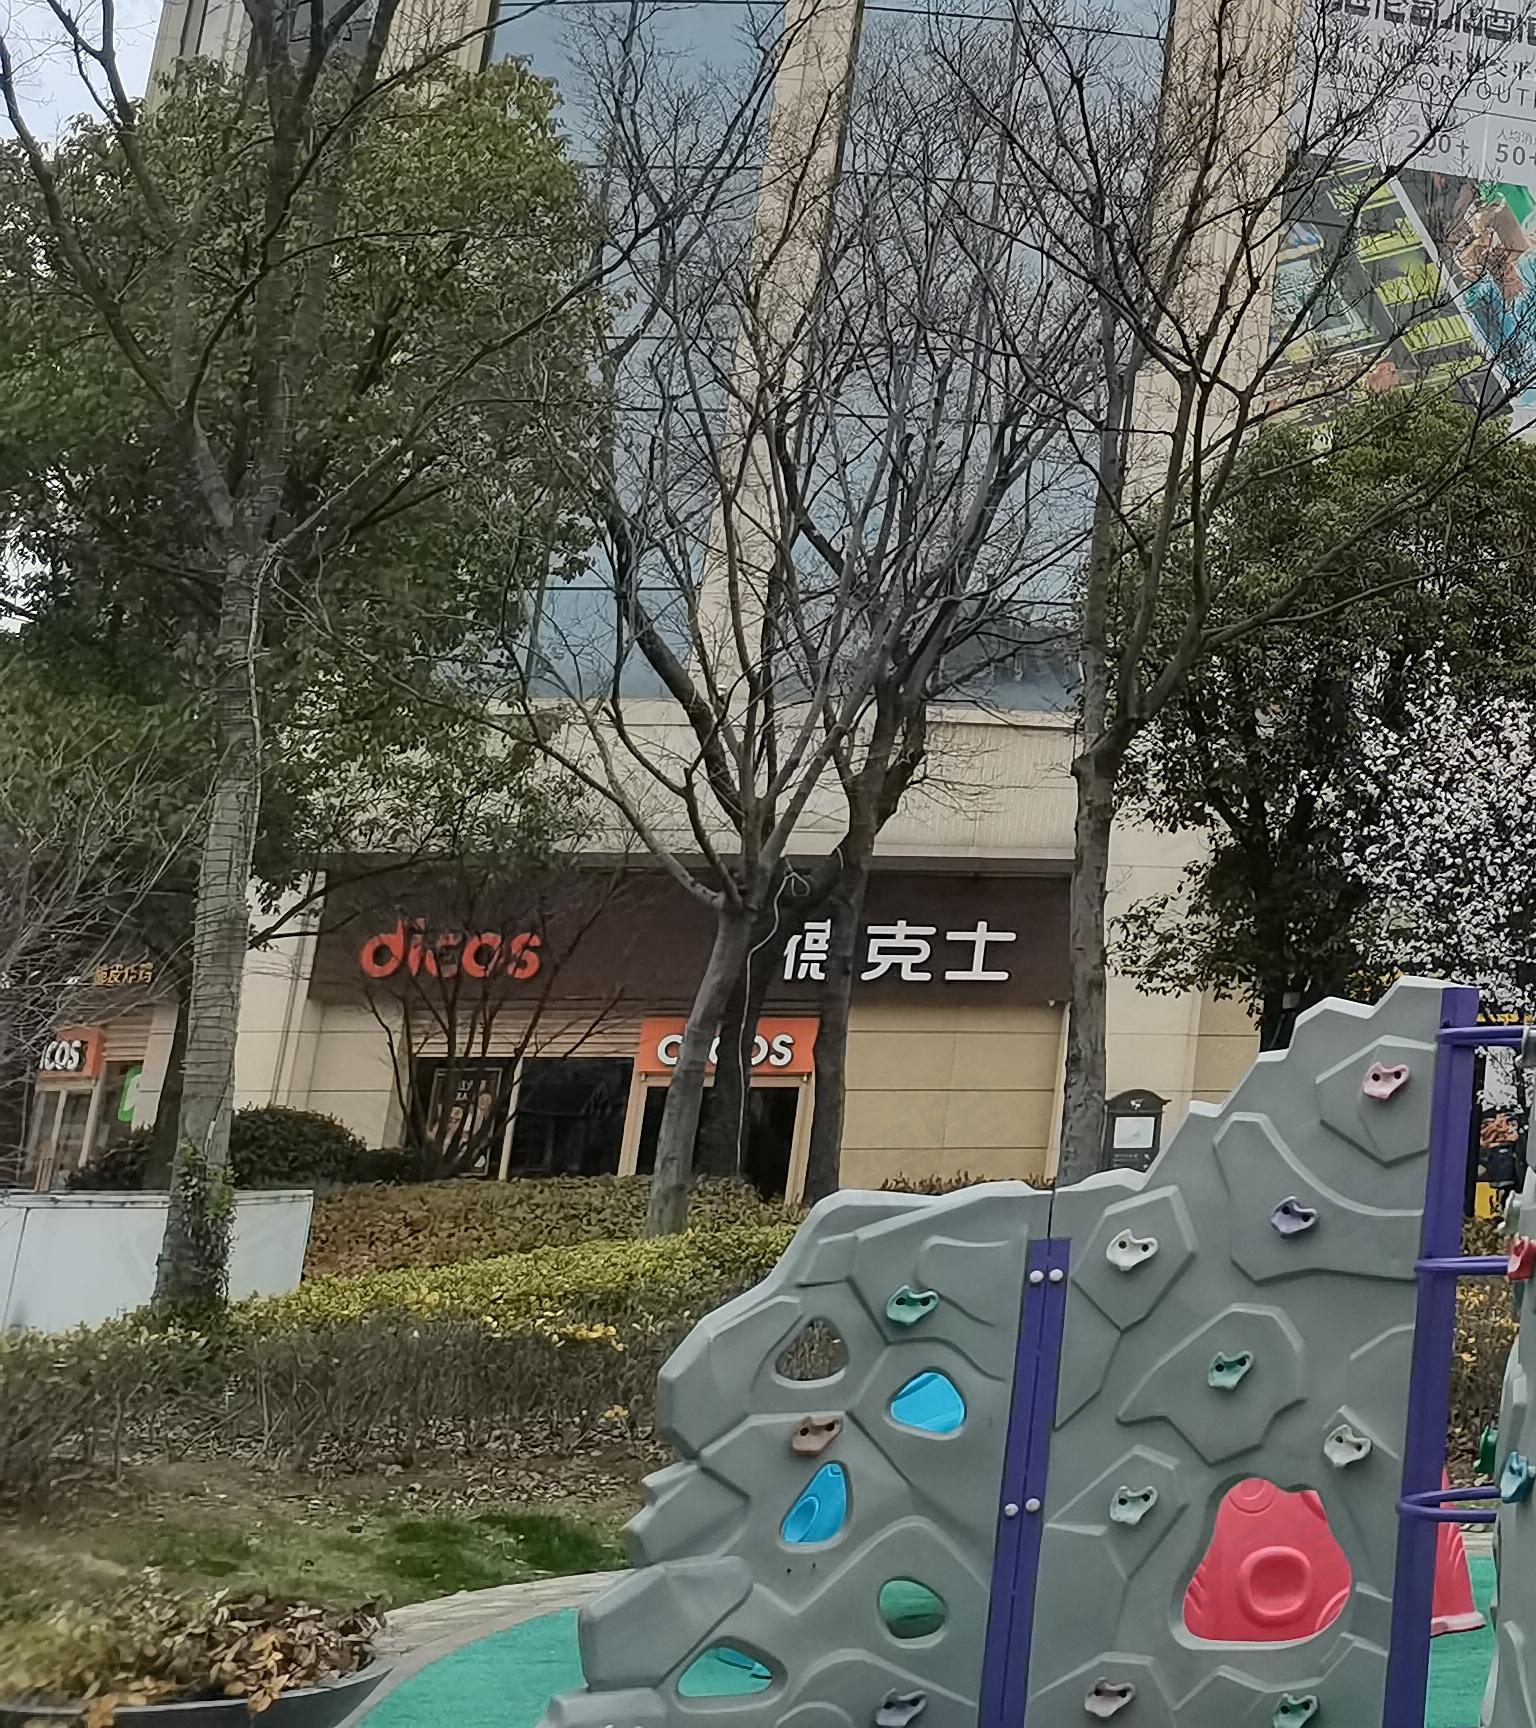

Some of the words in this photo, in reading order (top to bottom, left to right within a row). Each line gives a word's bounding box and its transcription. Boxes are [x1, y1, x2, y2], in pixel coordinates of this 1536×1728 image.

[358, 918, 544, 981] dicos
[782, 917, 1018, 982] 德克士
